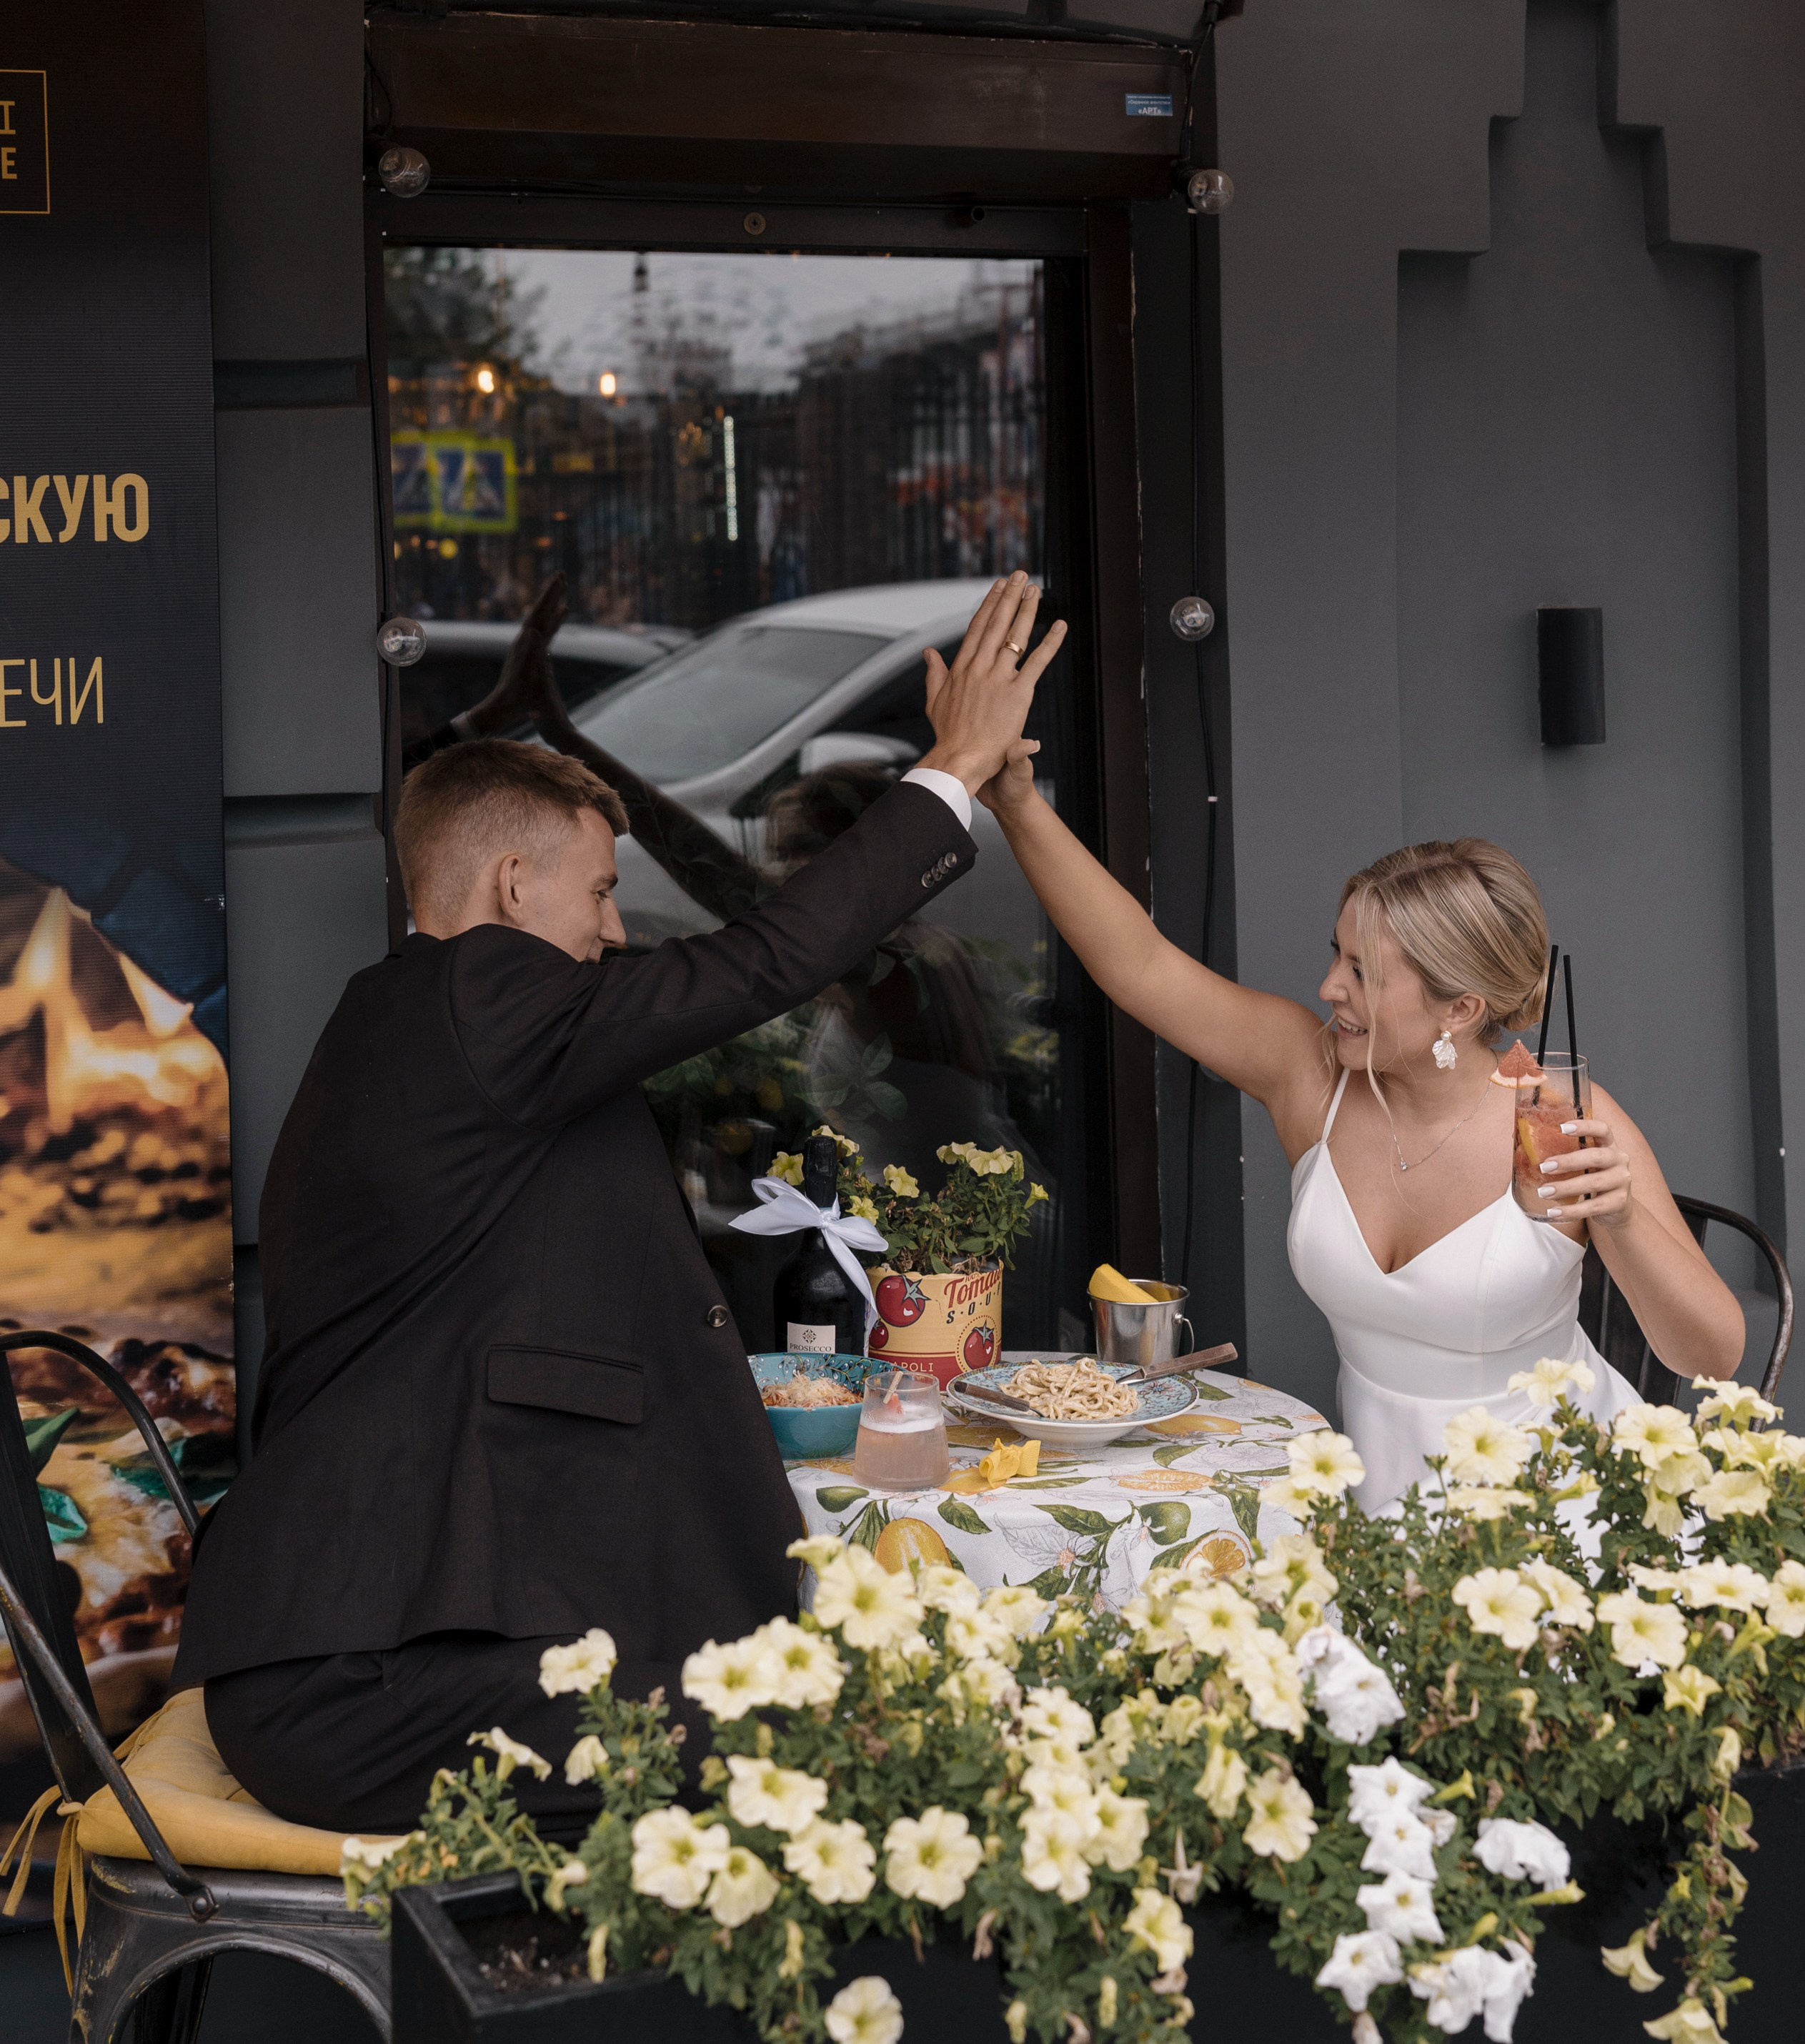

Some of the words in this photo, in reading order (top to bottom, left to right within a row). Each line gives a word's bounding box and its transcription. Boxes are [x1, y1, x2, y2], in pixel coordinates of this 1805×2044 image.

[0, 473, 149, 543] КУЮ
[0, 657, 104, 727] ЕЧИ
[790, 1343, 832, 1352] PROSECCO
[888, 1361, 934, 1372] POLI
